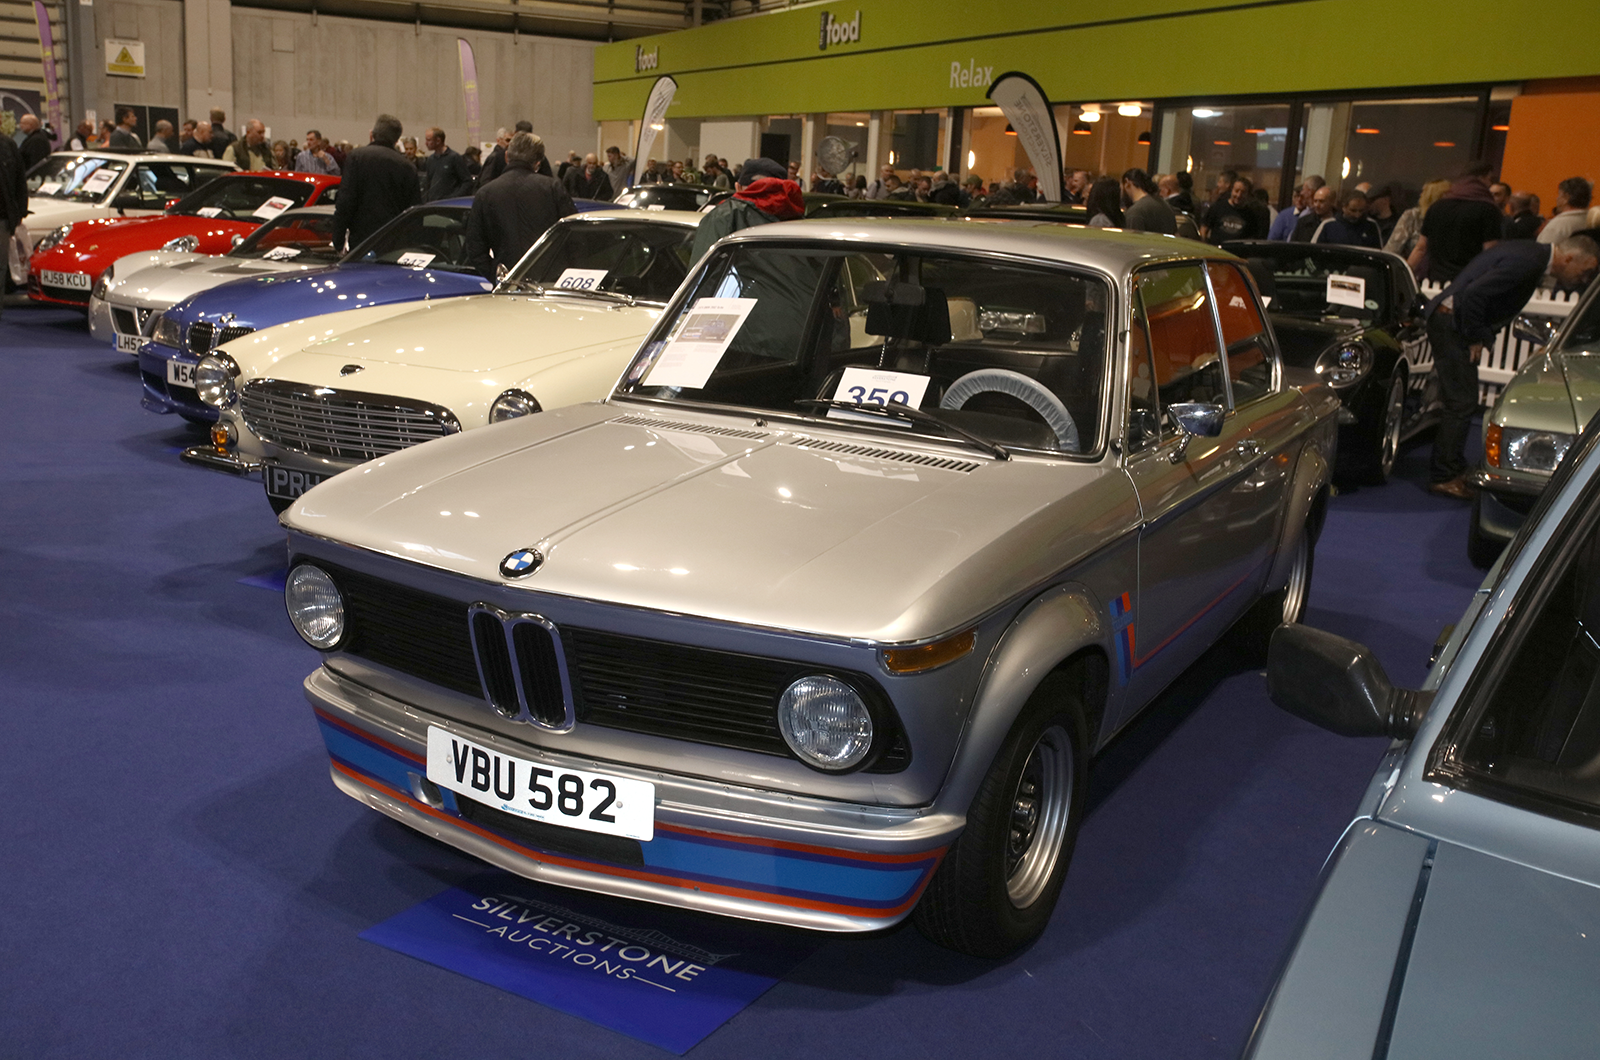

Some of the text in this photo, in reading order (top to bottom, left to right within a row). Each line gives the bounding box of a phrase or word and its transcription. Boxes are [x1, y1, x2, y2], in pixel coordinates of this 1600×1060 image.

[826, 10, 860, 44] food
[638, 45, 659, 71] food
[949, 57, 993, 88] Relax
[43, 270, 87, 287] HJ58 KCU
[560, 276, 596, 289] 608
[451, 738, 616, 824] VBU 582
[471, 896, 707, 982] SILVERSTONE
[486, 925, 637, 980] AUCTIONS
